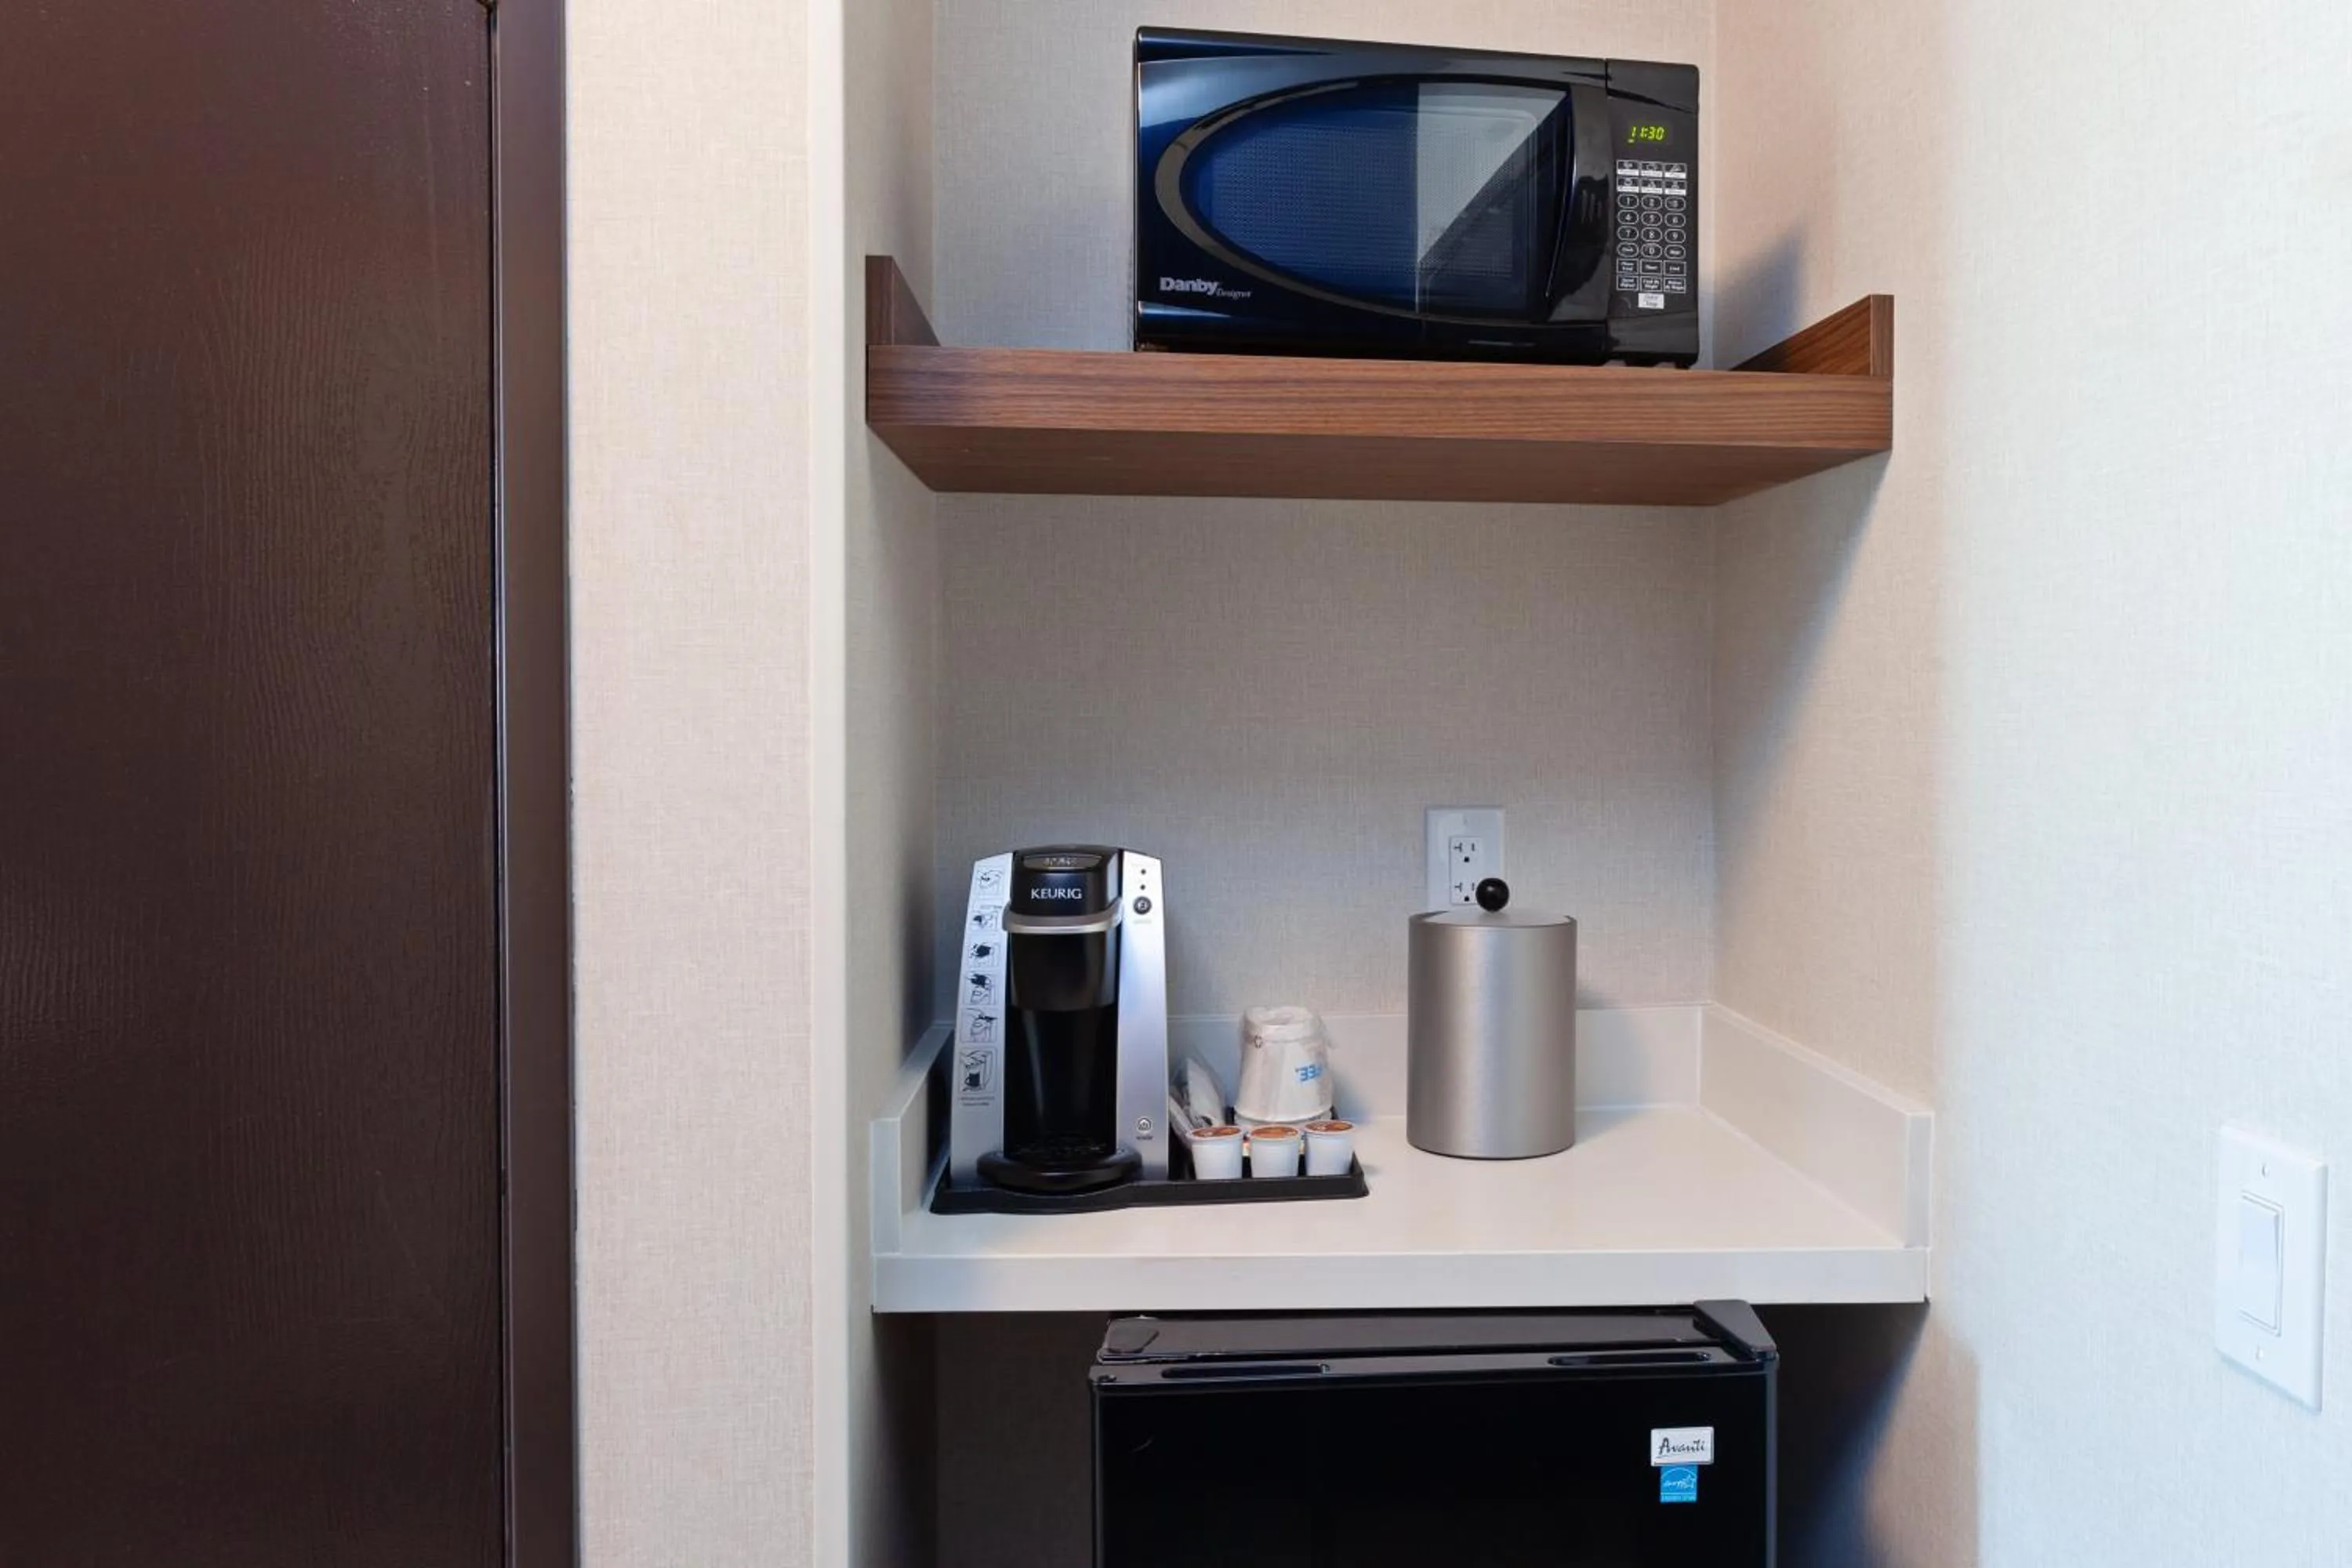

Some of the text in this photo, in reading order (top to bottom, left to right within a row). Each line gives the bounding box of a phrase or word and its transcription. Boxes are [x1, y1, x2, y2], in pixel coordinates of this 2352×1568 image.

[1631, 125, 1665, 141] 11:30
[1160, 276, 1218, 296] Danby
[1031, 887, 1083, 899] KEURIG
[1657, 1437, 1706, 1455] Avanti
